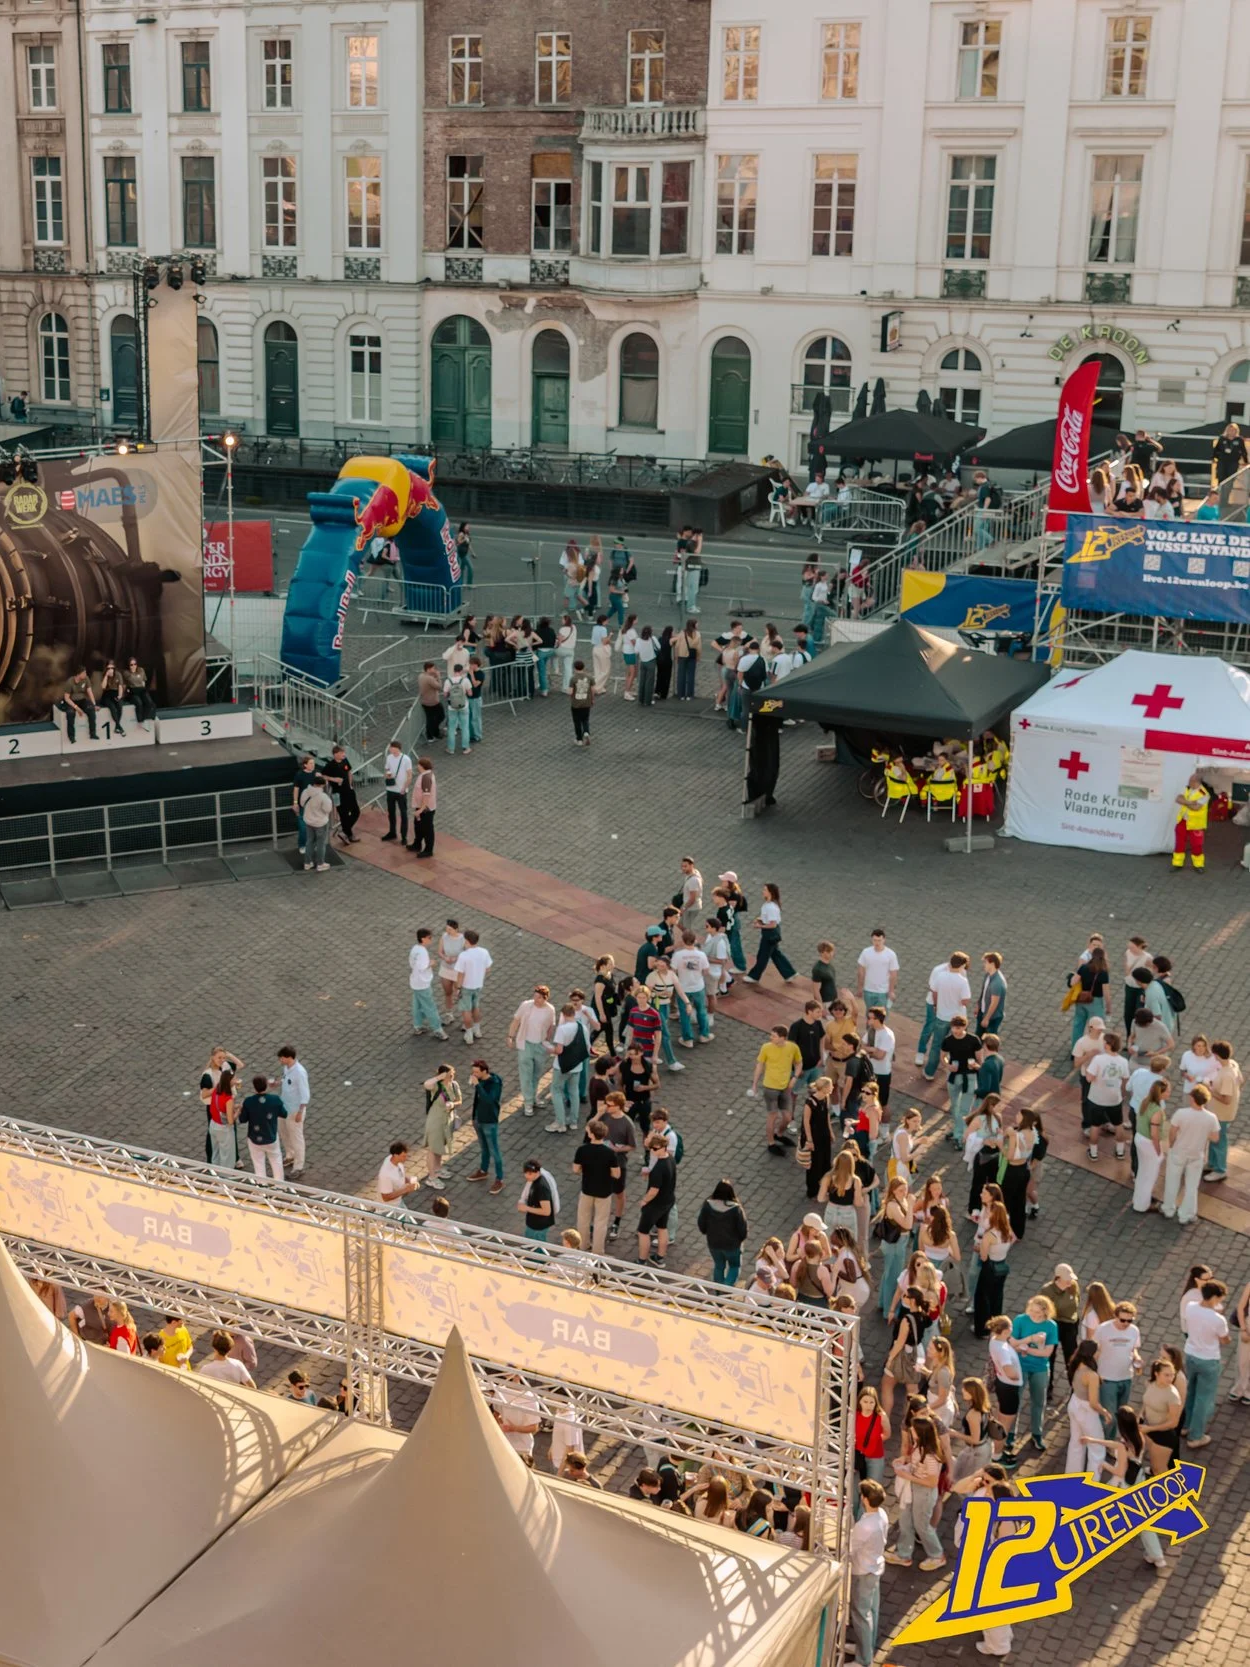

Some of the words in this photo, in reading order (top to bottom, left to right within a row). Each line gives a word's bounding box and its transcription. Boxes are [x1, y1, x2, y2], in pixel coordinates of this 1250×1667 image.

[1049, 336, 1072, 361] DE
[1081, 325, 1149, 365] KROON
[77, 485, 137, 508] MAES
[16, 503, 38, 514] WERK
[1147, 529, 1187, 543] VOLG
[1190, 532, 1227, 545] LIVE
[340, 571, 356, 611] Bull
[333, 608, 348, 649] Red
[102, 721, 111, 740] 1
[200, 720, 211, 736] 3
[8, 739, 20, 754] 2
[1064, 788, 1098, 804] Rode
[1102, 794, 1138, 810] Kruis
[1063, 799, 1136, 822] Vlaanderen
